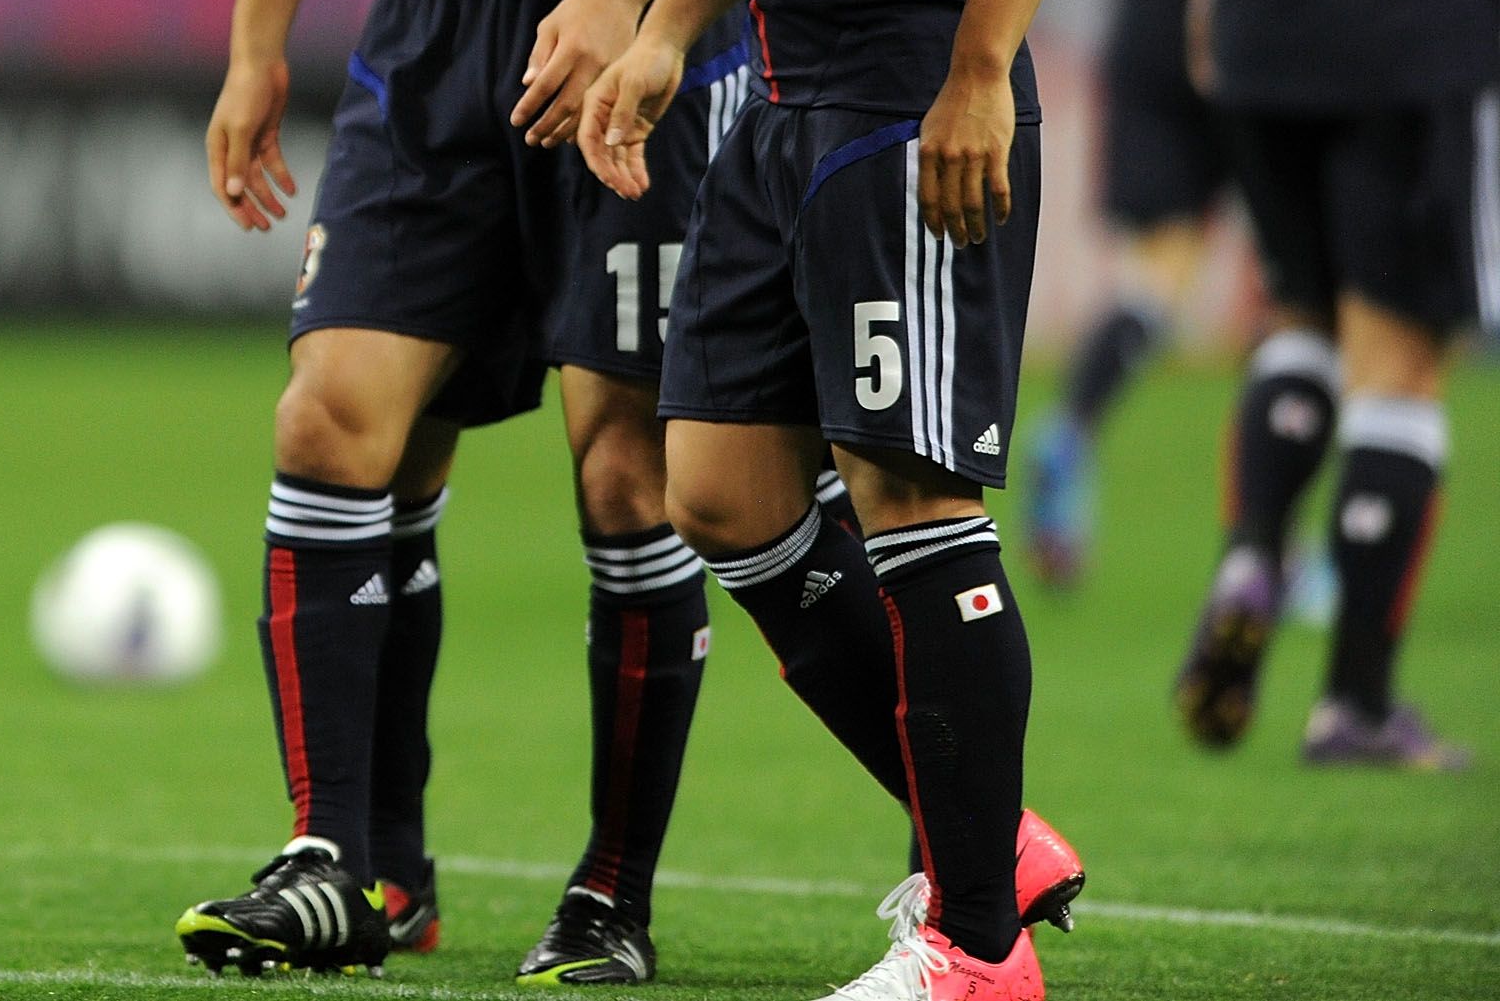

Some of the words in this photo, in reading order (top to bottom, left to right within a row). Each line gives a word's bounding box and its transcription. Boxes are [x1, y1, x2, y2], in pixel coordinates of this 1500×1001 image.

[854, 301, 902, 411] 5
[973, 442, 1000, 456] adidas
[800, 571, 842, 609] adidas
[967, 981, 977, 994] 5
